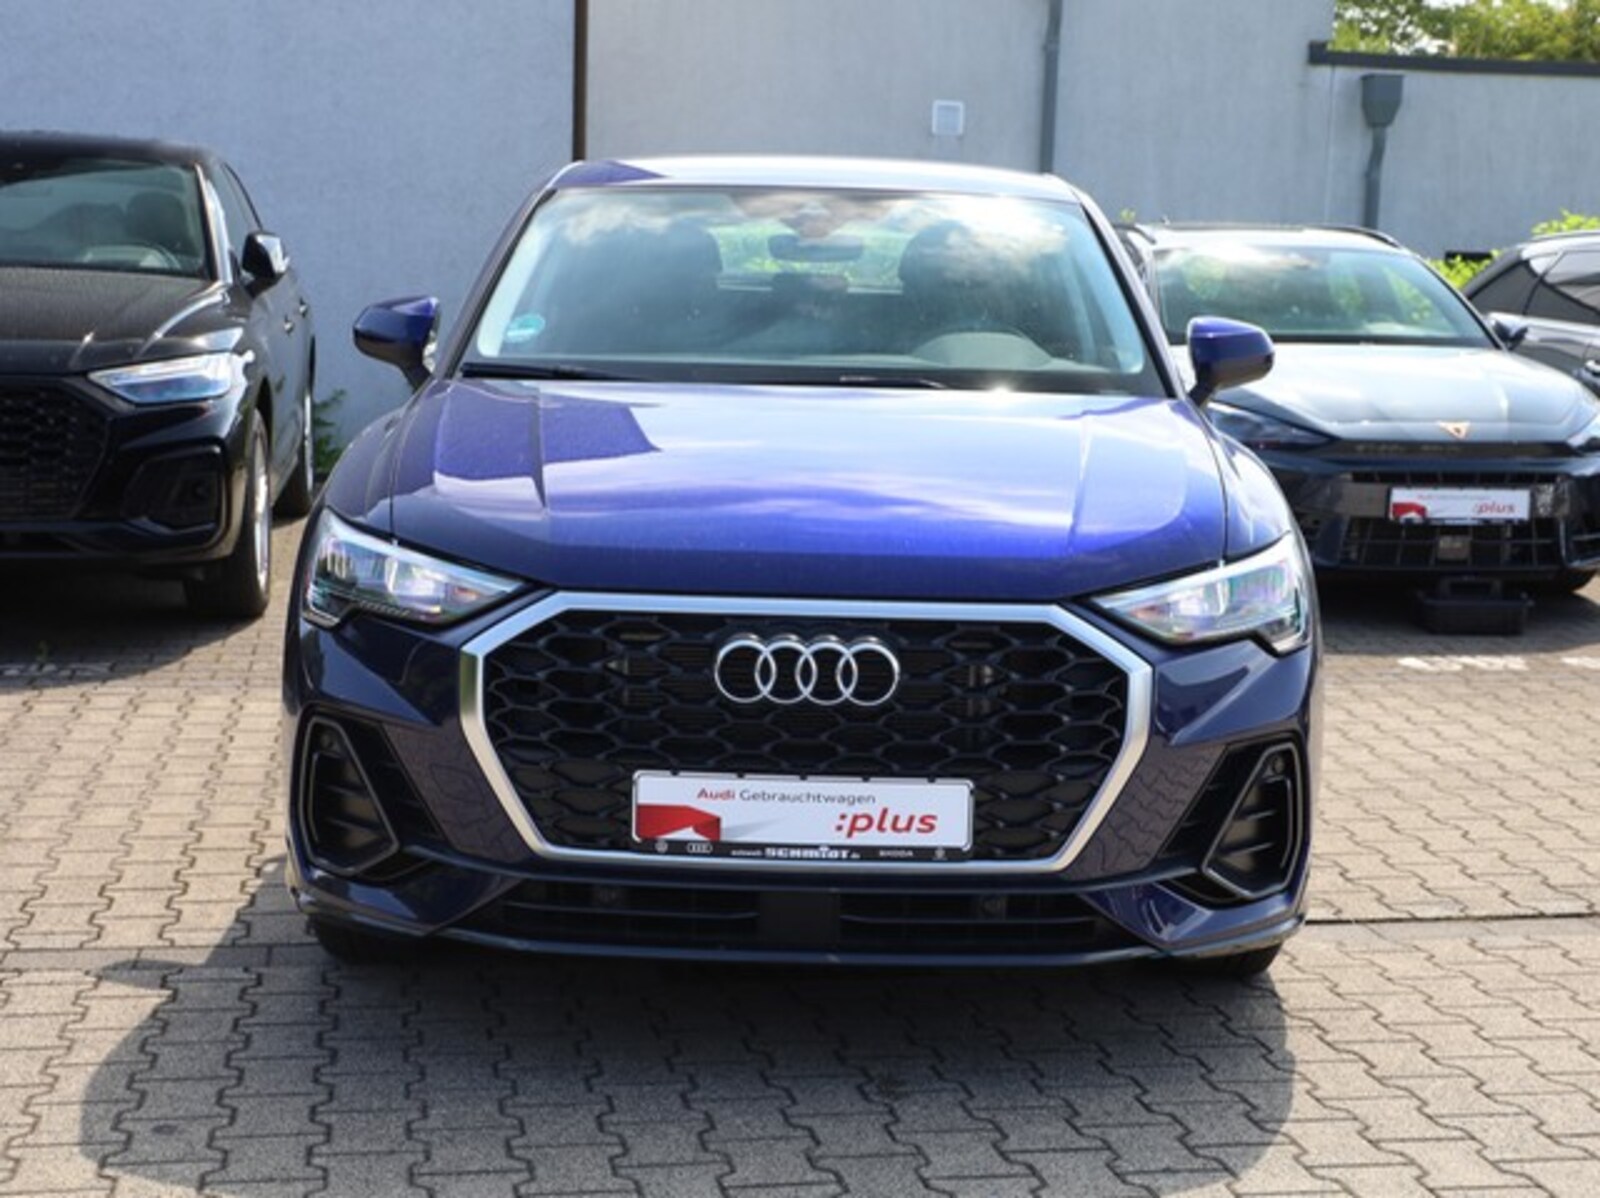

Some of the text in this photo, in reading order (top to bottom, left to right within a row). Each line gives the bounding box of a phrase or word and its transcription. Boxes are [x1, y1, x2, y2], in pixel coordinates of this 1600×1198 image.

[697, 788, 876, 805] Audi Gebrauchtwagen
[835, 807, 937, 838] :plus
